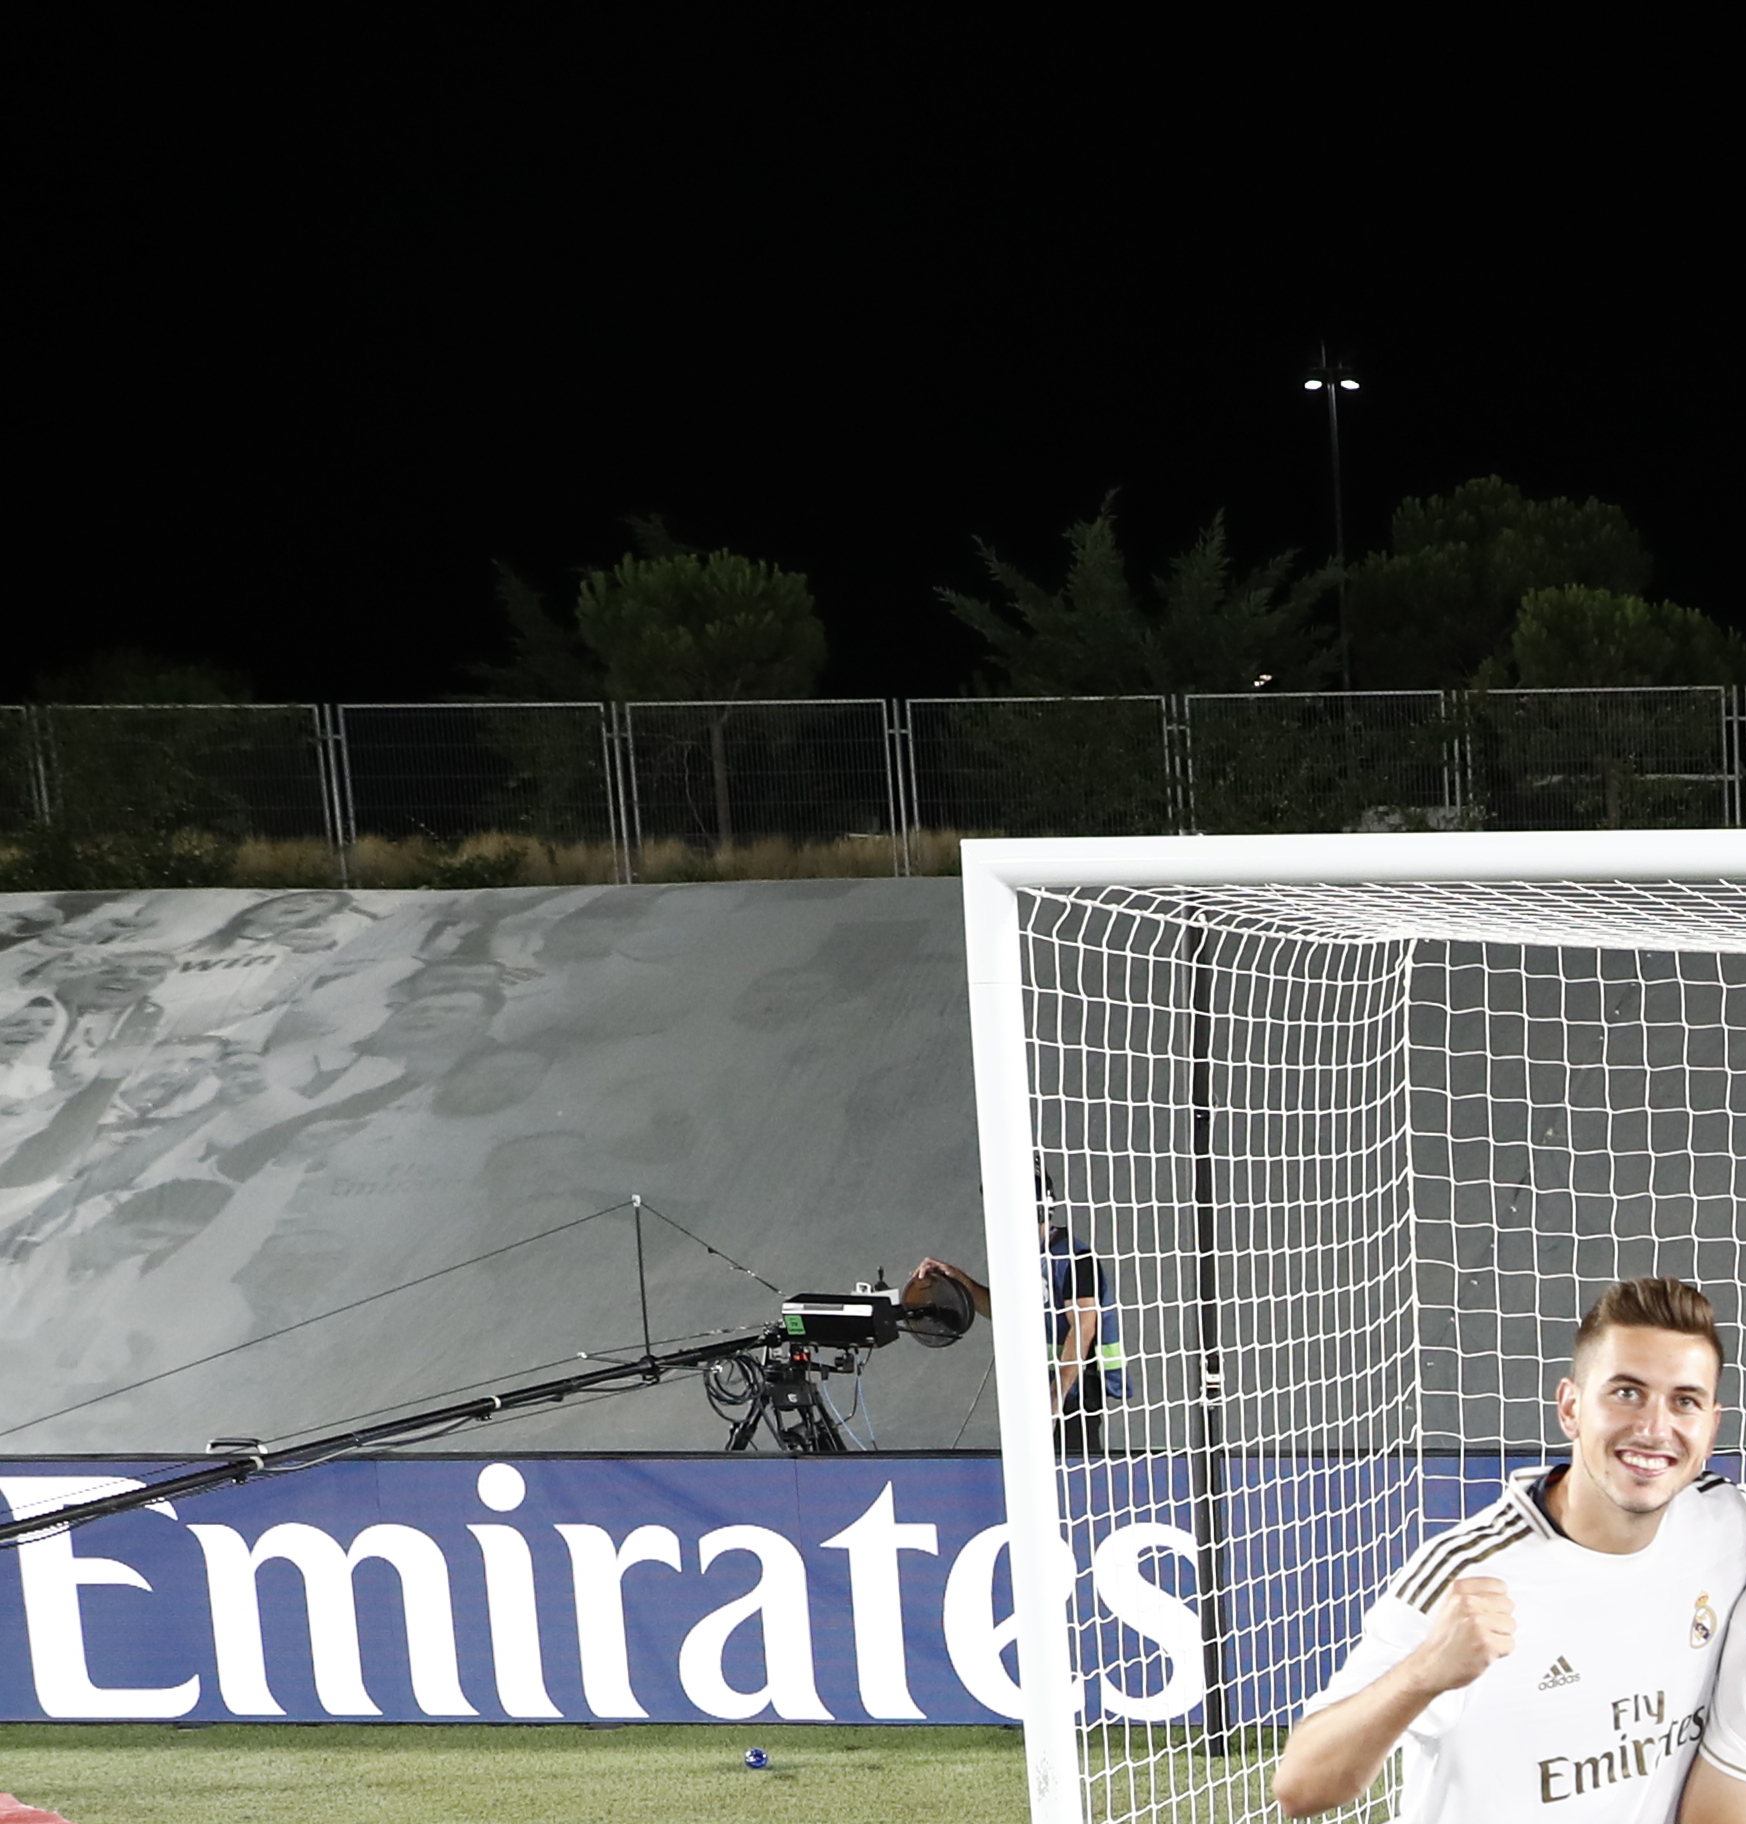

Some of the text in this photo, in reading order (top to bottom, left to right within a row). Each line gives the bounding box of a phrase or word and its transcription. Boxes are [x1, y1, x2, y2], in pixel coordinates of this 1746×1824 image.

[0, 1463, 1206, 1722] Emirates
[1538, 1673, 1581, 1691] adidas
[1611, 1690, 1665, 1731] Fly
[1538, 1705, 1706, 1804] Emirtes
